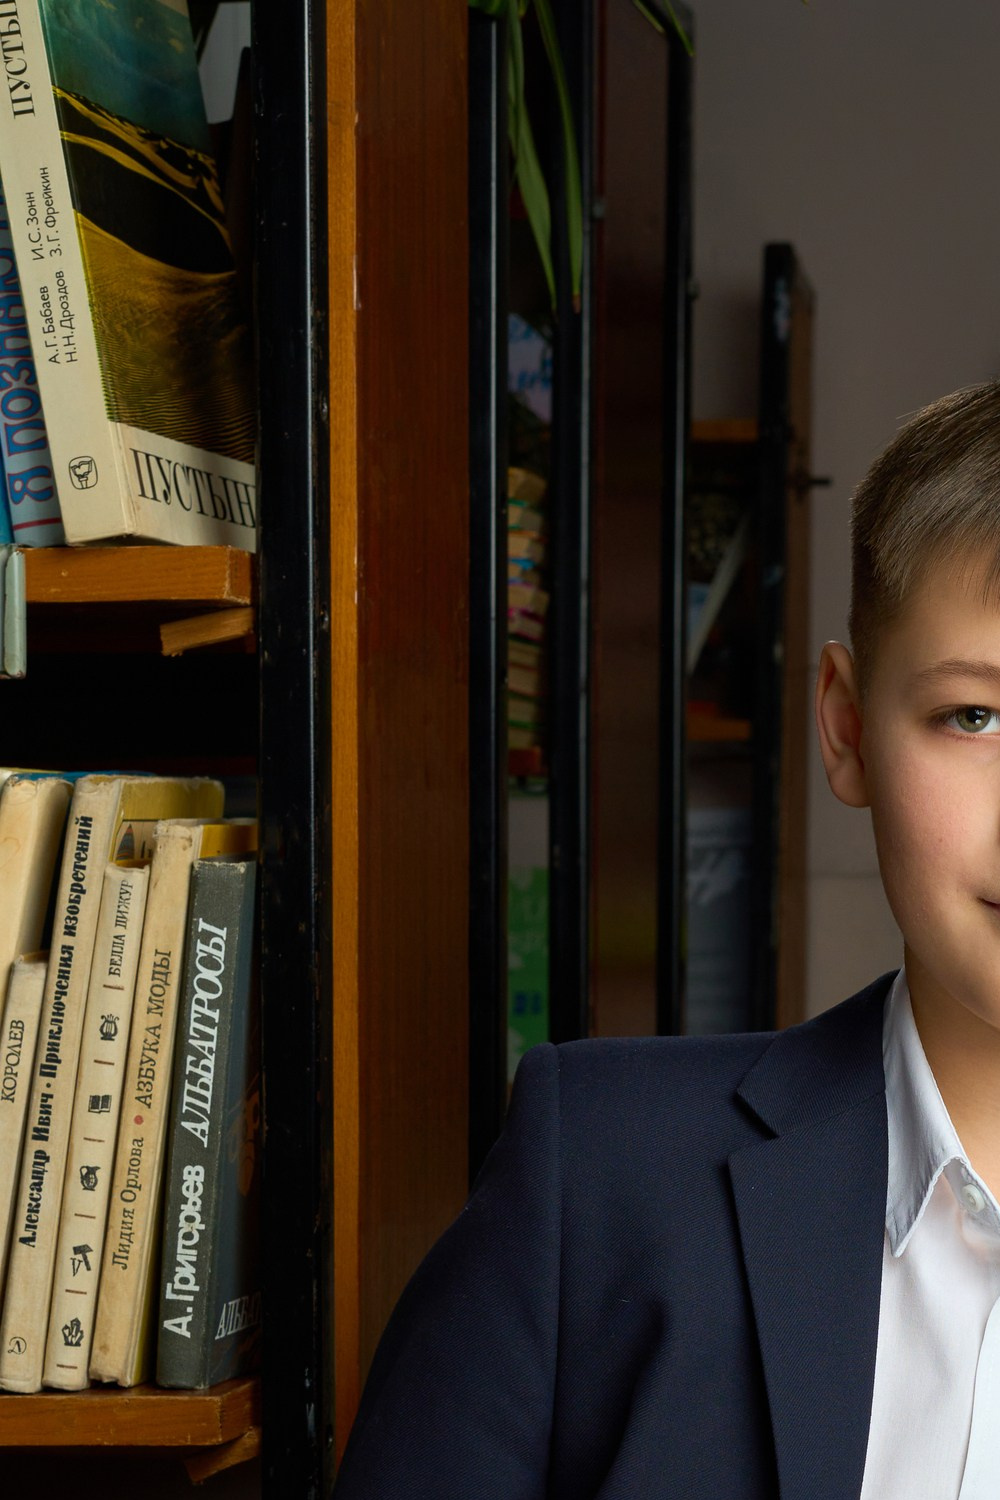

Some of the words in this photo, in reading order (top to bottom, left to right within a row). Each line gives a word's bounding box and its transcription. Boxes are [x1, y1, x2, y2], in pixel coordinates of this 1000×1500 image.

[63, 815, 94, 938] изобретений
[39, 944, 75, 1079] Приключения
[153, 948, 172, 1018] МОДЫ
[134, 1023, 163, 1108] АЗБУКА
[181, 918, 228, 1148] АЛЬБАТРОСЫ
[31, 1092, 54, 1142] Ивич
[19, 1150, 51, 1248] Александр
[120, 1137, 145, 1204] Орлова
[112, 1208, 136, 1270] Лидия
